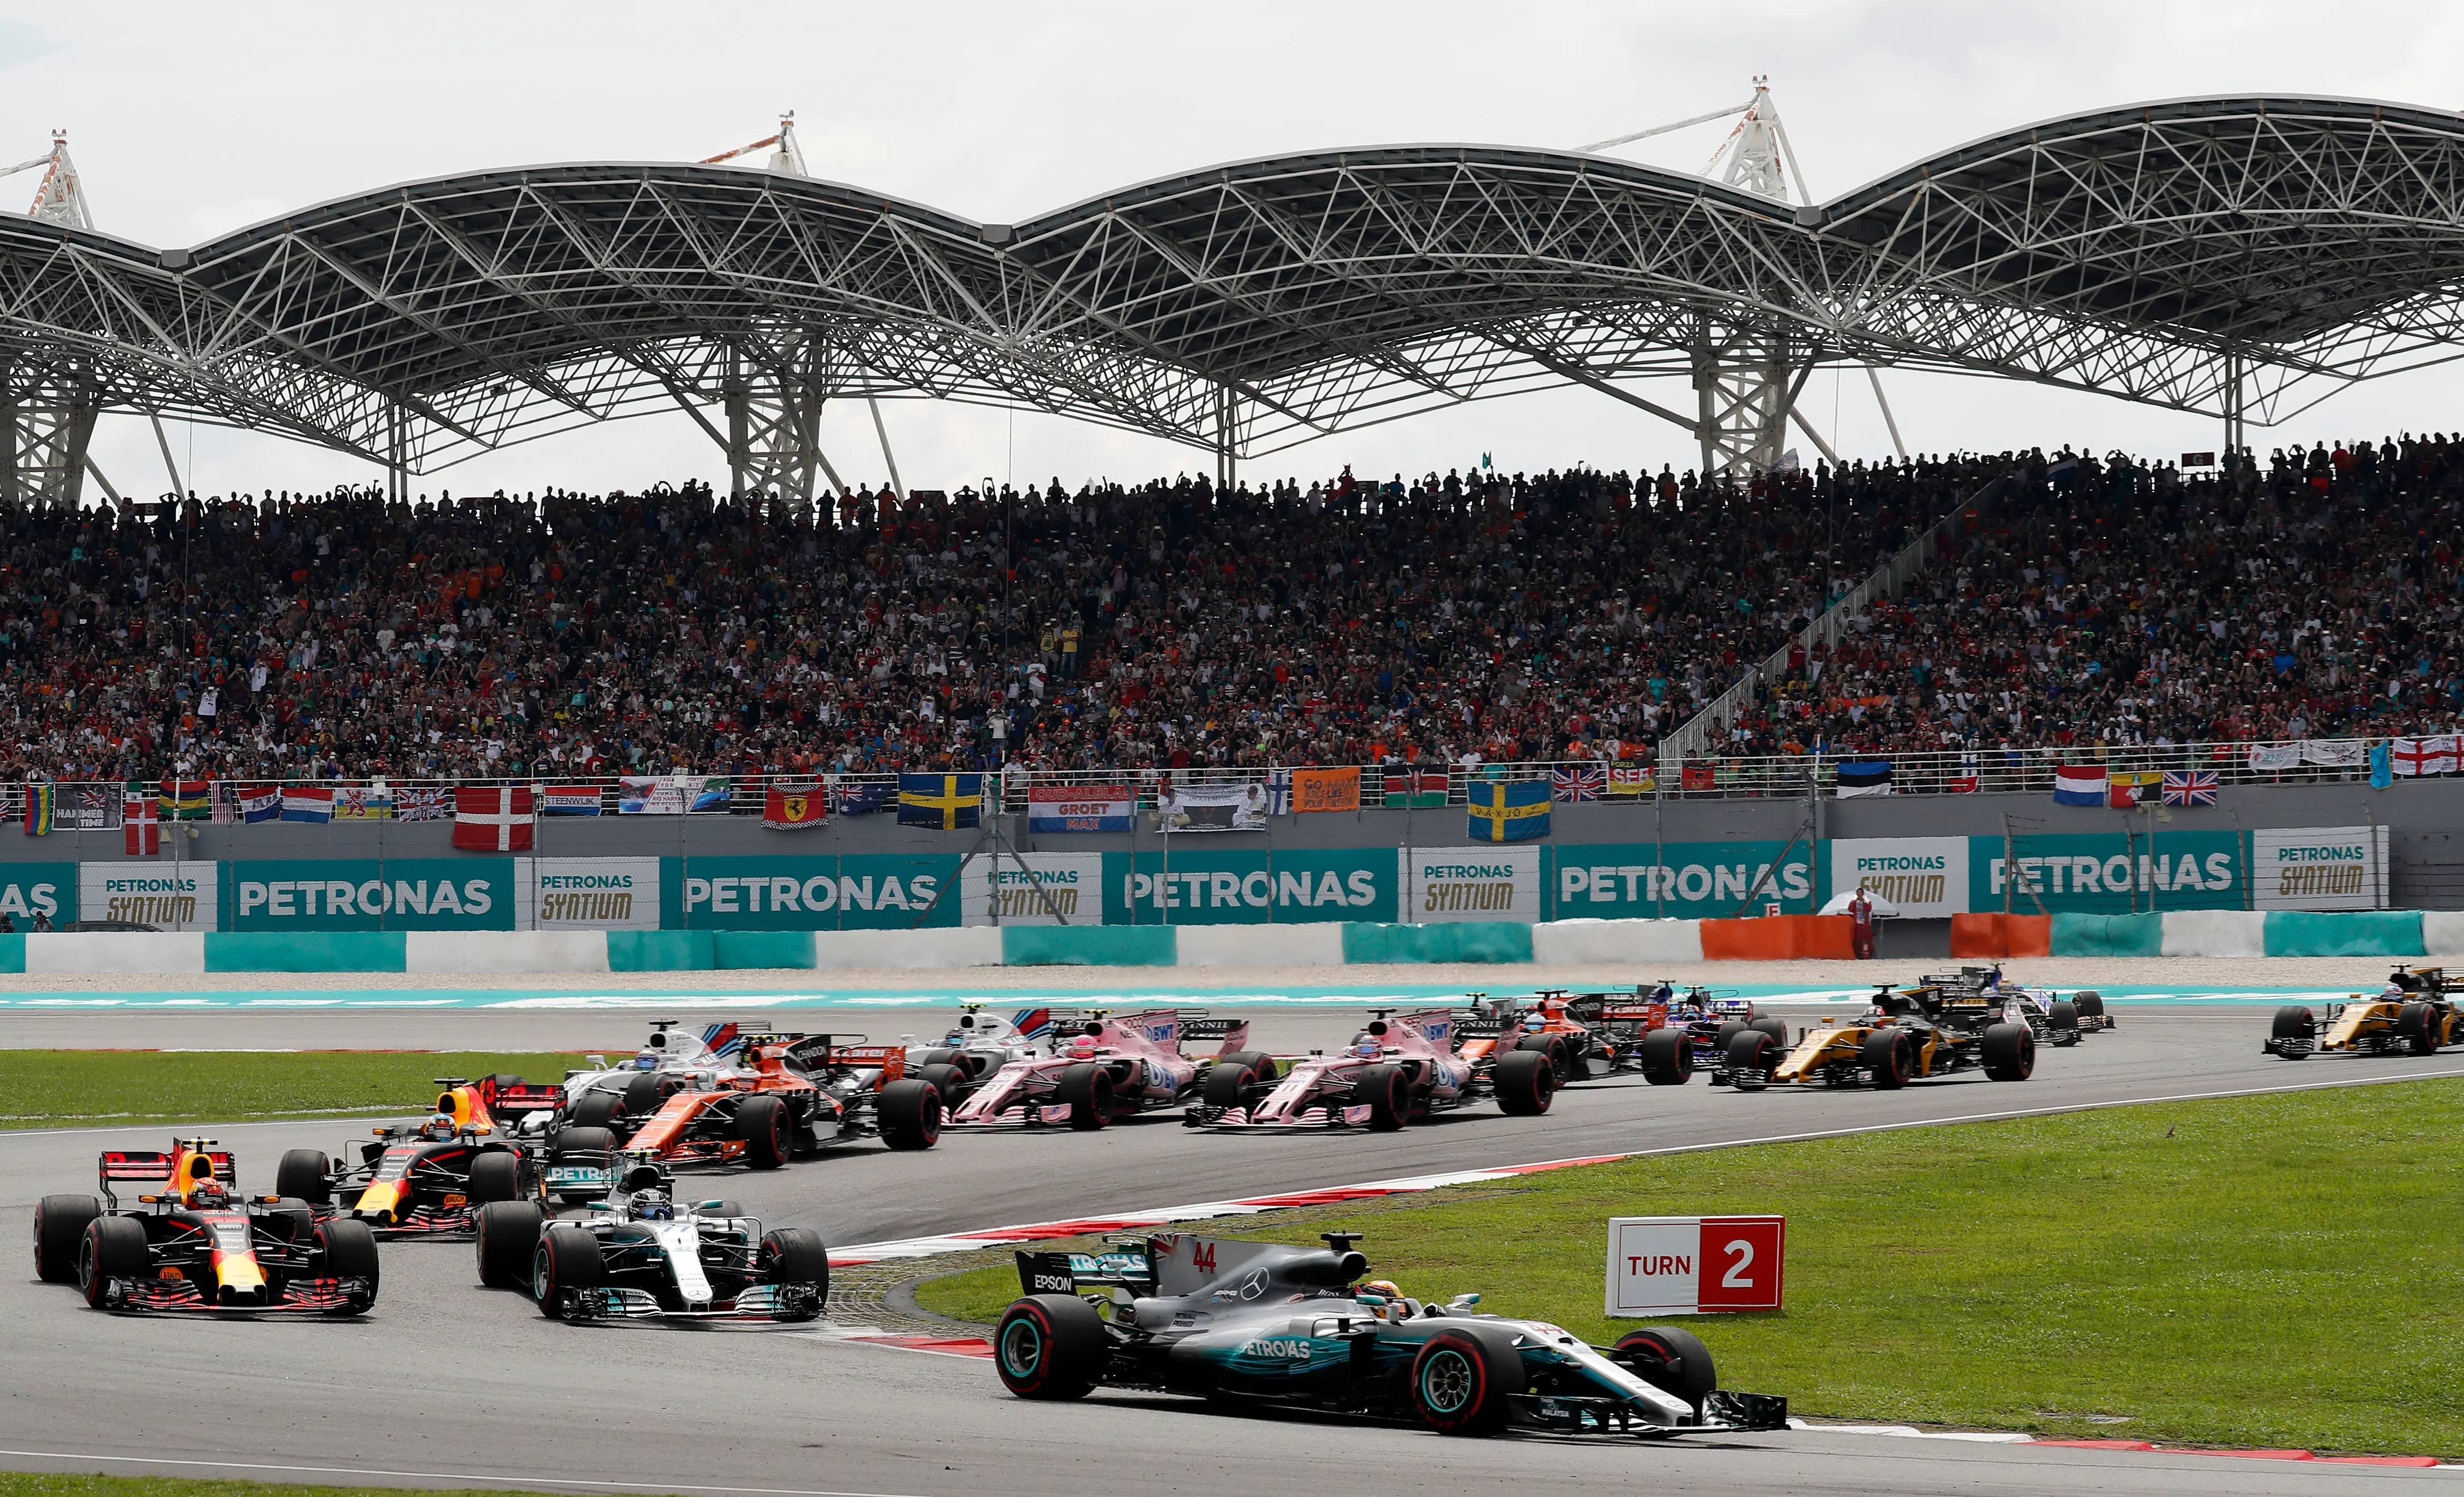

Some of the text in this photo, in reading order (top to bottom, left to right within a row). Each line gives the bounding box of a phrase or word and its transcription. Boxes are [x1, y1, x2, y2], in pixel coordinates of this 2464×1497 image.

[2193, 454, 2203, 465] G
[145, 504, 155, 514] B
[1304, 779, 1322, 789] GO
[1613, 768, 1650, 785] SEB
[1059, 804, 1109, 815] GROET
[1067, 818, 1100, 829] MAX
[2279, 846, 2364, 861] PETRONAS
[1857, 855, 1945, 870] PETRONAS
[1425, 865, 1513, 878] PETRONAS
[1991, 852, 2232, 894] PETRONAS
[2279, 865, 2364, 895] SYNTIUM
[106, 879, 196, 892] PETRONAS
[541, 875, 632, 889] PETRONAS
[1124, 870, 1376, 908] PETRONAS
[1561, 863, 1810, 902] PETRONAS
[240, 880, 491, 917] PETRONAS
[686, 875, 938, 912] PETRONAS
[1425, 882, 1514, 911] SYNTIUM
[107, 896, 196, 923] SYNTIUM
[541, 893, 632, 920] SYNTIUM
[1153, 1024, 1173, 1042] BWT
[1430, 1023, 1448, 1041] BWT
[1193, 1242, 1217, 1274] 44
[1628, 1240, 1754, 1288] TURN 2
[1035, 1274, 1072, 1291] EPSON
[1542, 1409, 1570, 1417] MALAYSIA
